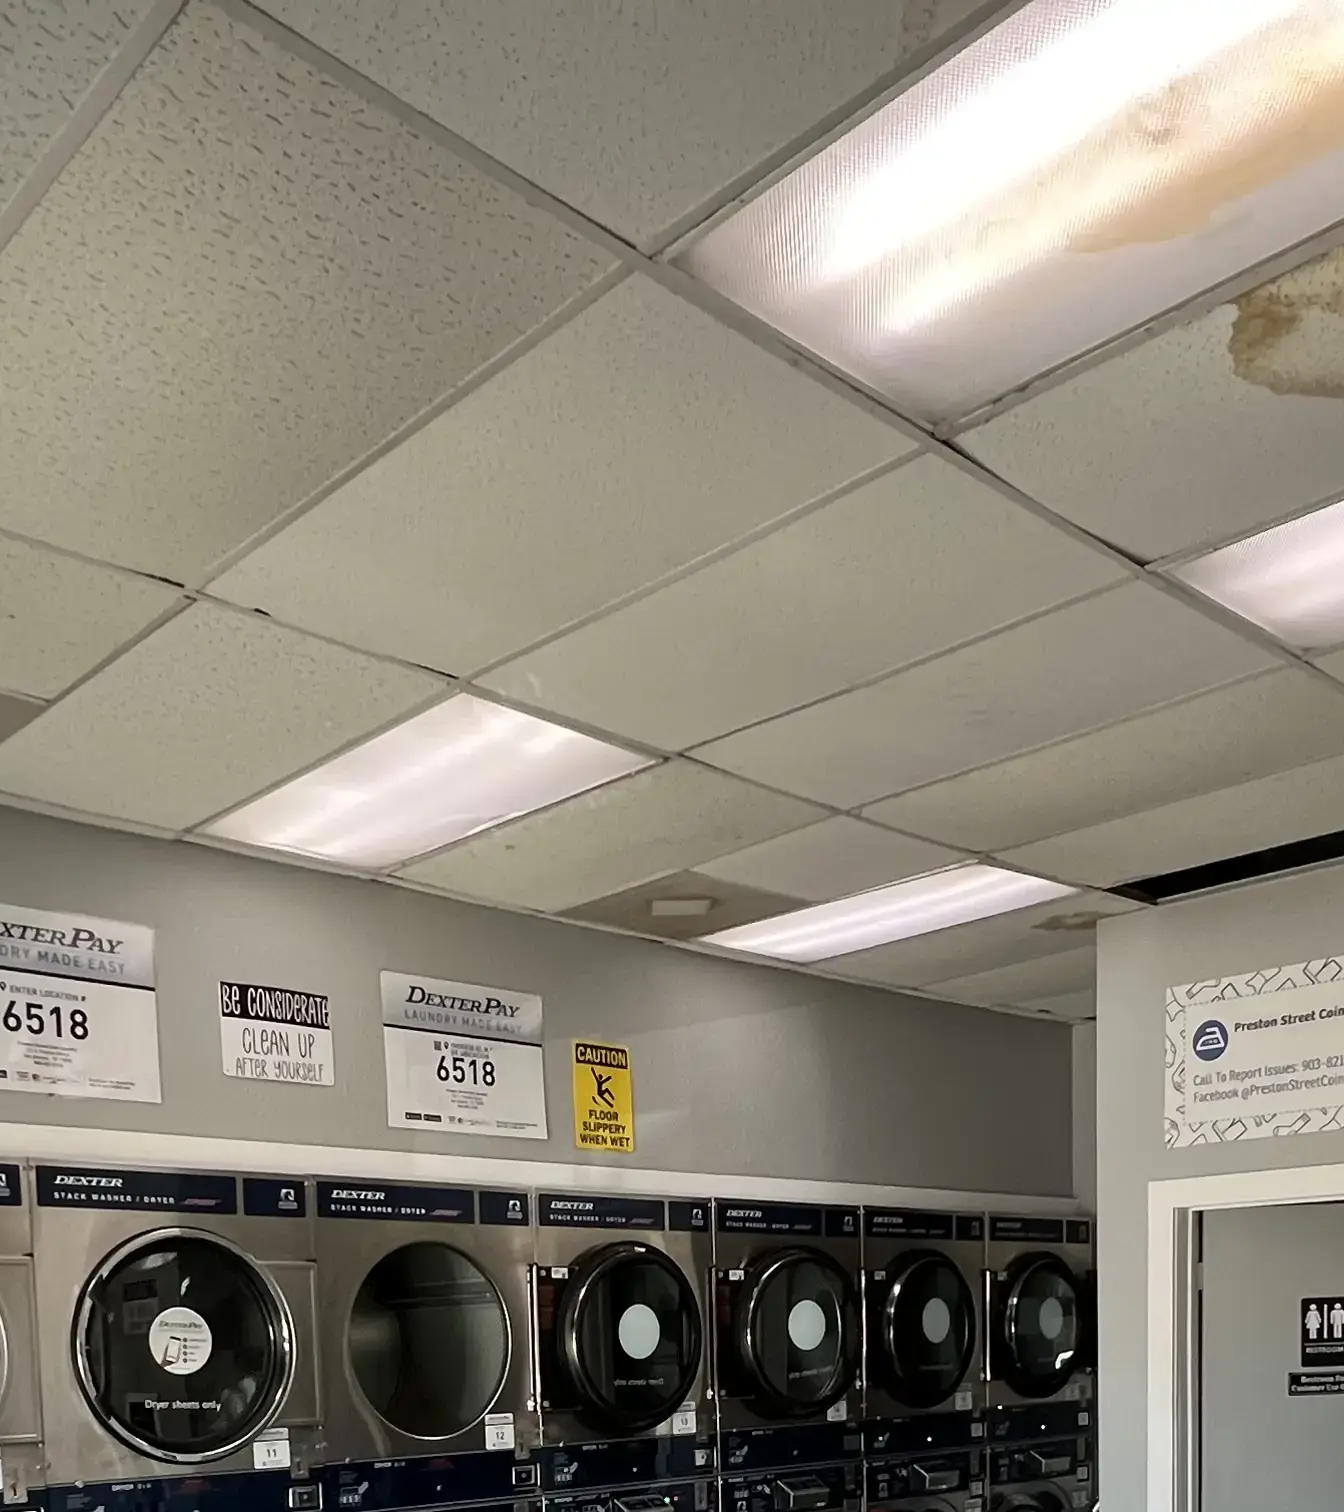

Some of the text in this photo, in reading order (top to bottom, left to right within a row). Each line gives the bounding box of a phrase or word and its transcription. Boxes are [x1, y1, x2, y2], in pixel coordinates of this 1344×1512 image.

[37, 948, 83, 970] MADE
[88, 956, 126, 976] EASY
[10, 984, 38, 996] ENTER
[40, 988, 79, 1001] LOCATION
[247, 987, 330, 1028] CONSIDERATE
[3, 1000, 90, 1041] 6518
[404, 1008, 456, 1025] LAUNDRY
[460, 1015, 489, 1031] MADE
[1233, 1016, 1278, 1033] Preston
[1279, 1010, 1316, 1027] Street
[242, 1027, 316, 1059] CLEAN UP
[576, 1045, 627, 1069] CAUTION
[235, 1057, 324, 1084] AFTER YOURSELF
[436, 1055, 496, 1087] 6518
[1192, 1070, 1213, 1087] Call
[1215, 1069, 1227, 1084] To
[1228, 1066, 1263, 1087] Report
[588, 1108, 619, 1123] FLOOR
[582, 1120, 627, 1136] SLIPPERY
[579, 1132, 630, 1149] WHEN WET
[54, 1175, 123, 1188] DEXTER
[54, 1191, 87, 1201] STACK
[91, 1193, 133, 1204] WASHER
[143, 1195, 176, 1205] DRYER
[331, 1189, 386, 1201] DEXTER
[550, 1200, 594, 1211] DEXTER
[726, 1208, 763, 1219] DEXTER
[144, 1399, 222, 1411] Dryer sheets only
[495, 1431, 505, 1440] 12
[266, 1448, 277, 1458] 11
